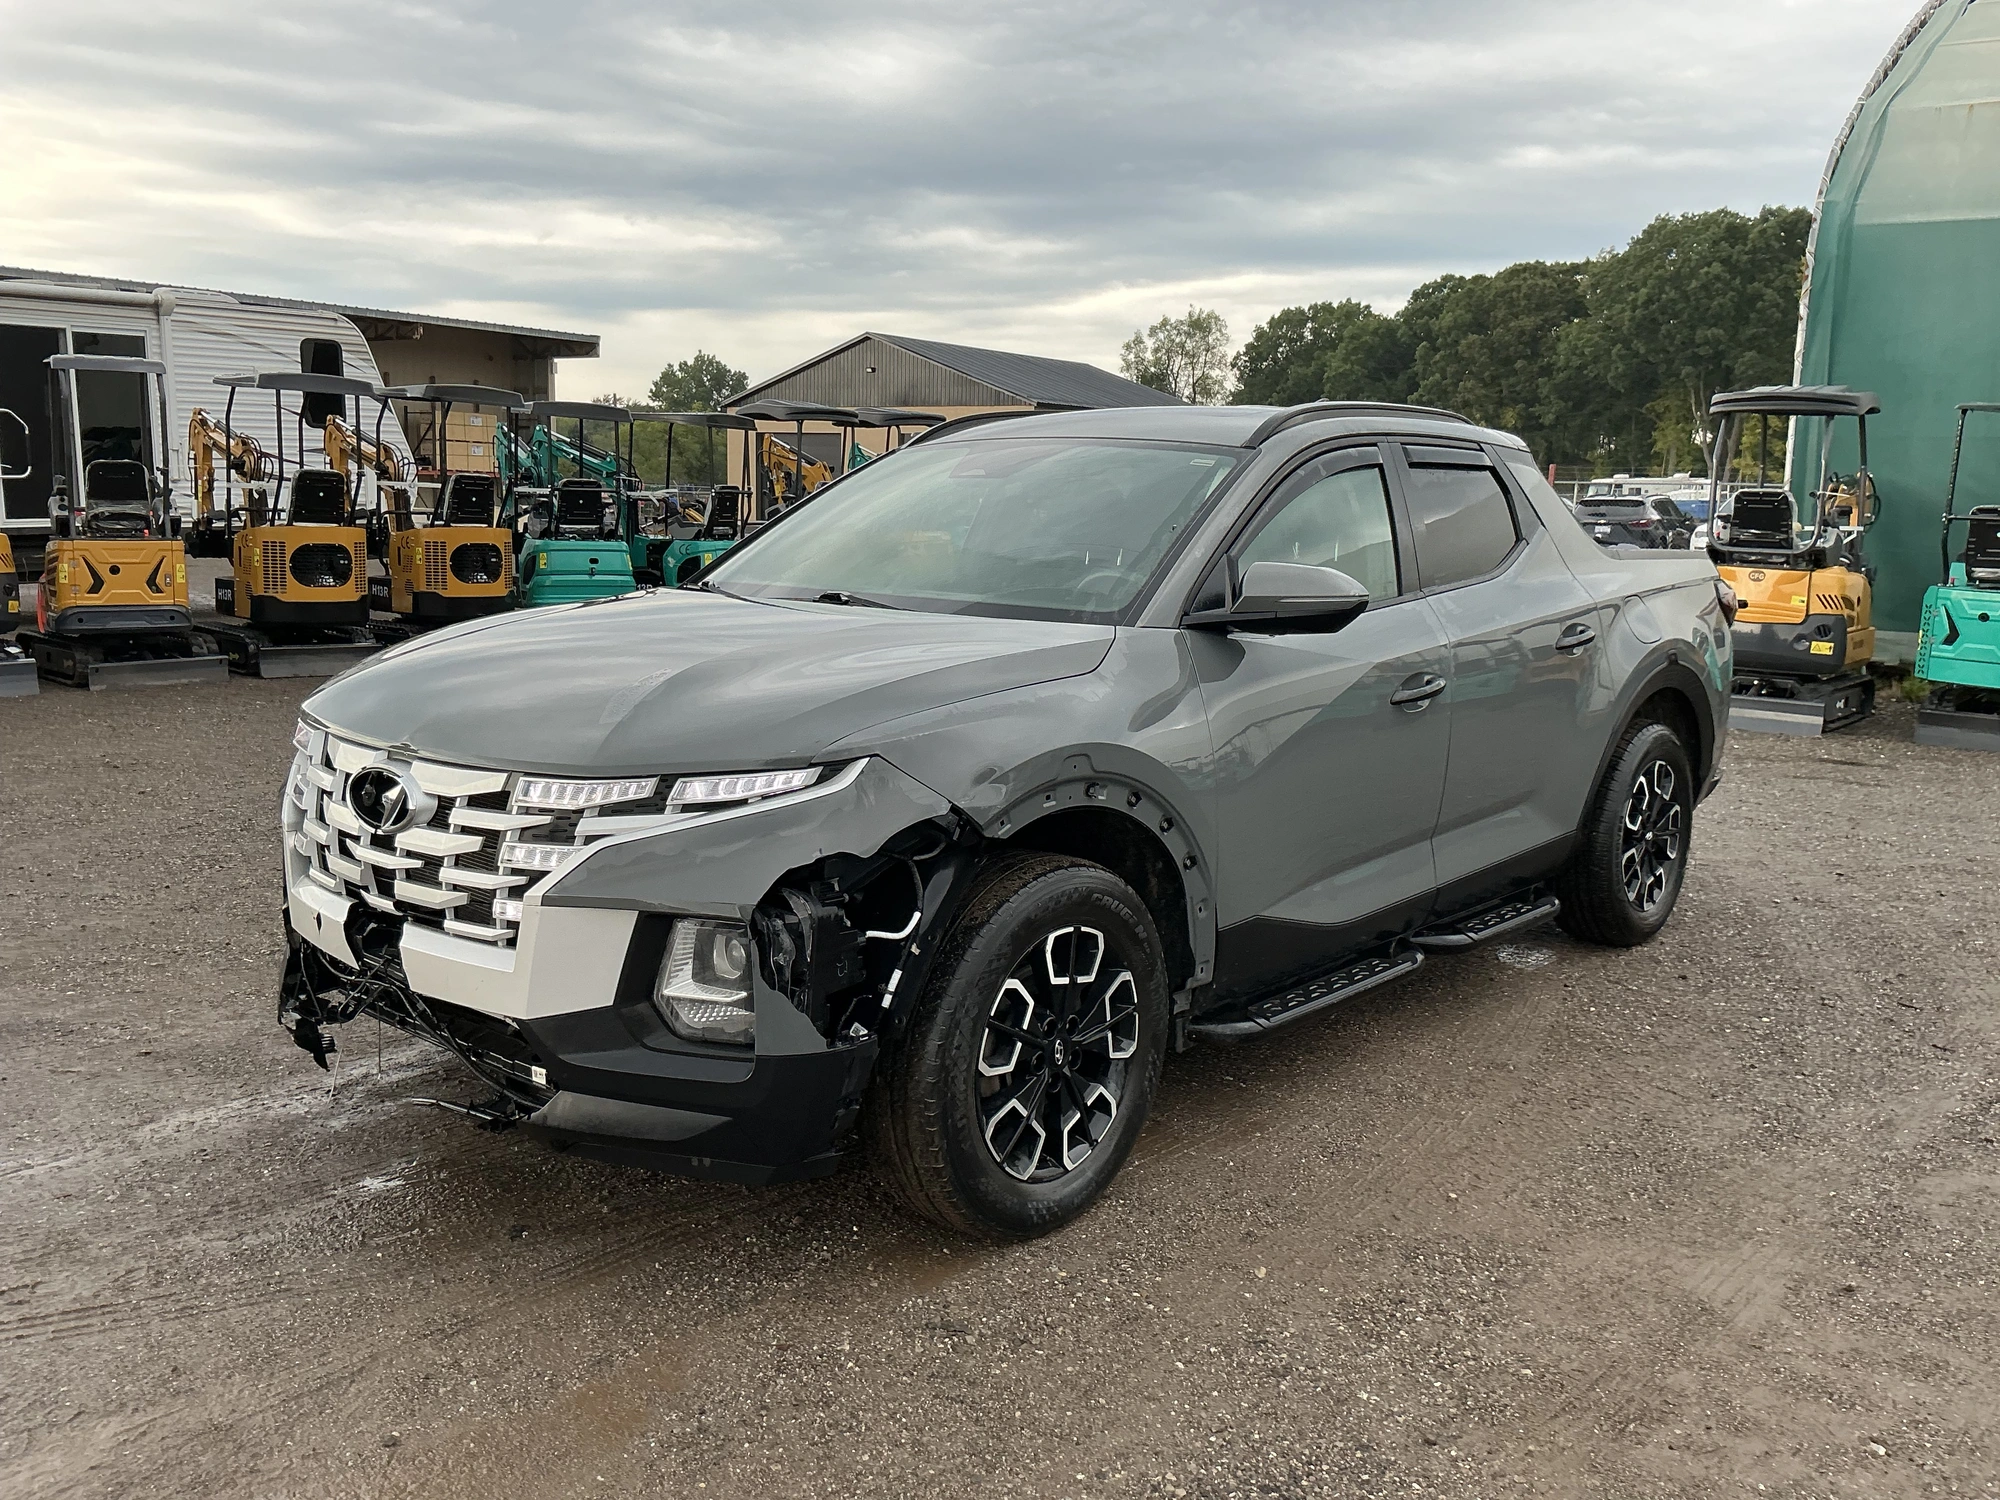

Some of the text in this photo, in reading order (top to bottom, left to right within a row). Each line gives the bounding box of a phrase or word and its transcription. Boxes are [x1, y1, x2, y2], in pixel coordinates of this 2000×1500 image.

[679, 544, 691, 555] CE
[1750, 572, 1765, 580] CFG
[217, 588, 232, 601] H13R
[372, 584, 389, 598] H13R
